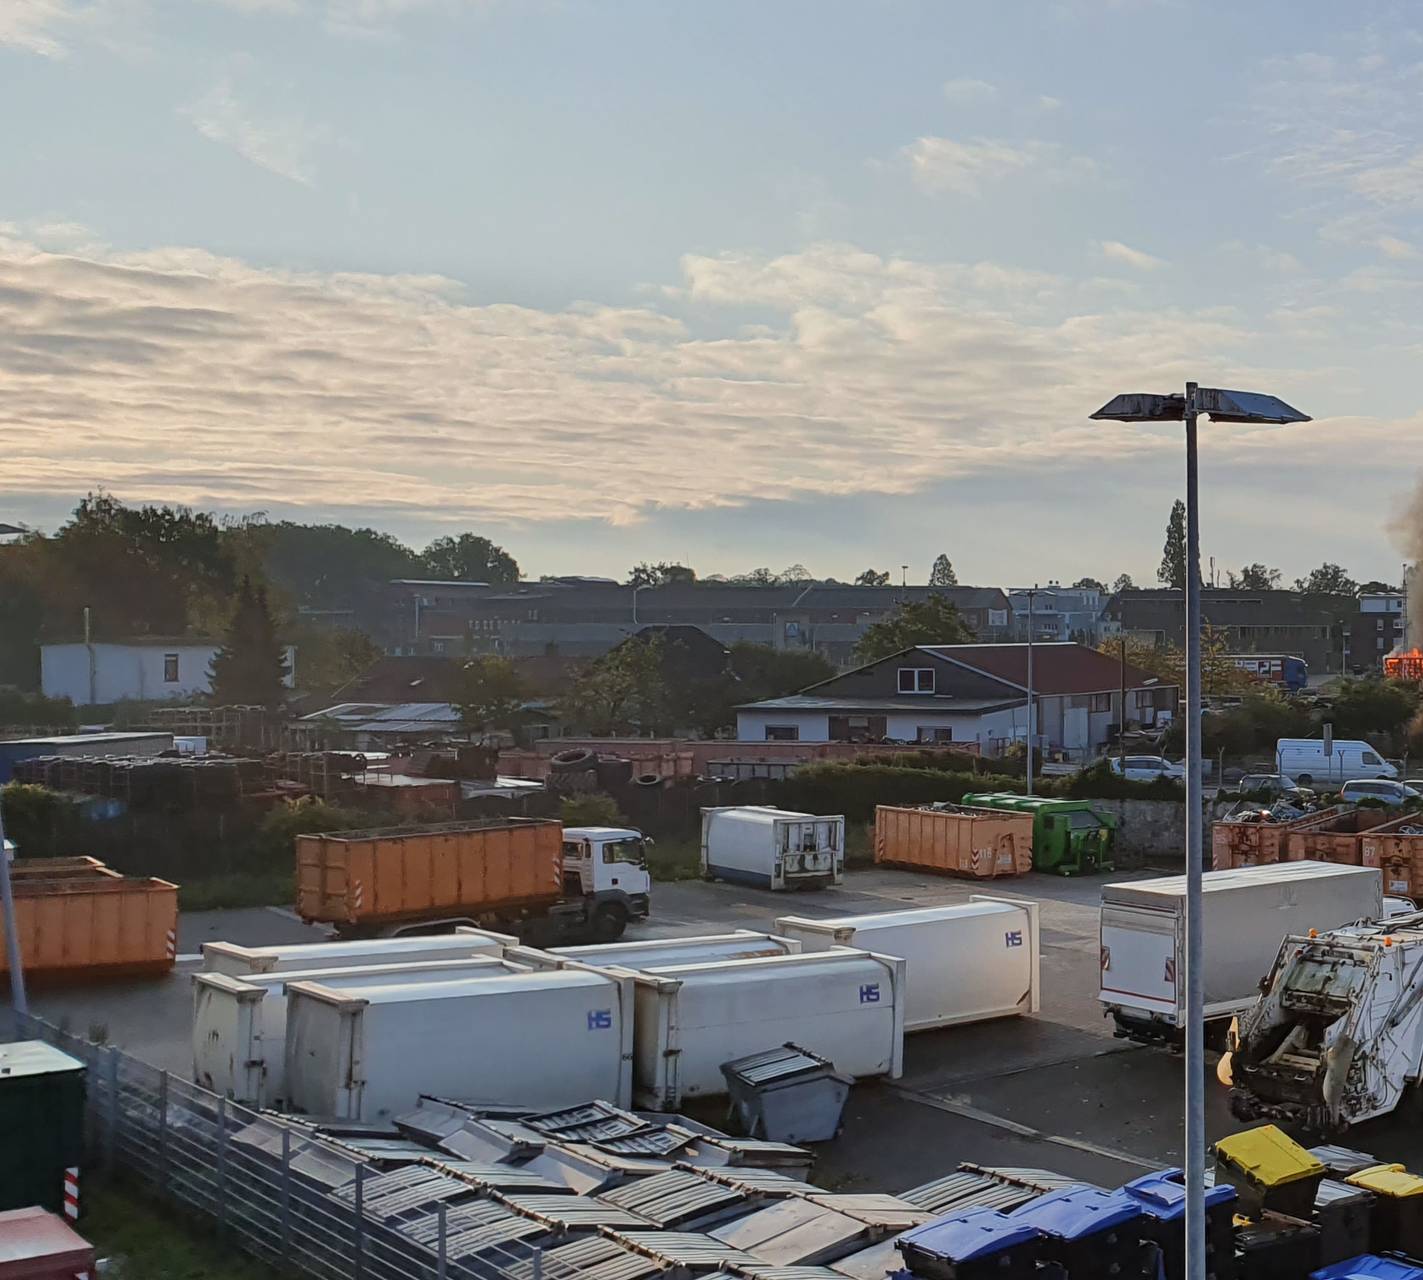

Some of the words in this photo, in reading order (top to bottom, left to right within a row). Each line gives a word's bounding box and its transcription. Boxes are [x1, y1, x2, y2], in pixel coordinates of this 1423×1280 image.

[1005, 930, 1022, 948] HS
[860, 983, 880, 1004] HS
[588, 1009, 612, 1031] HS
